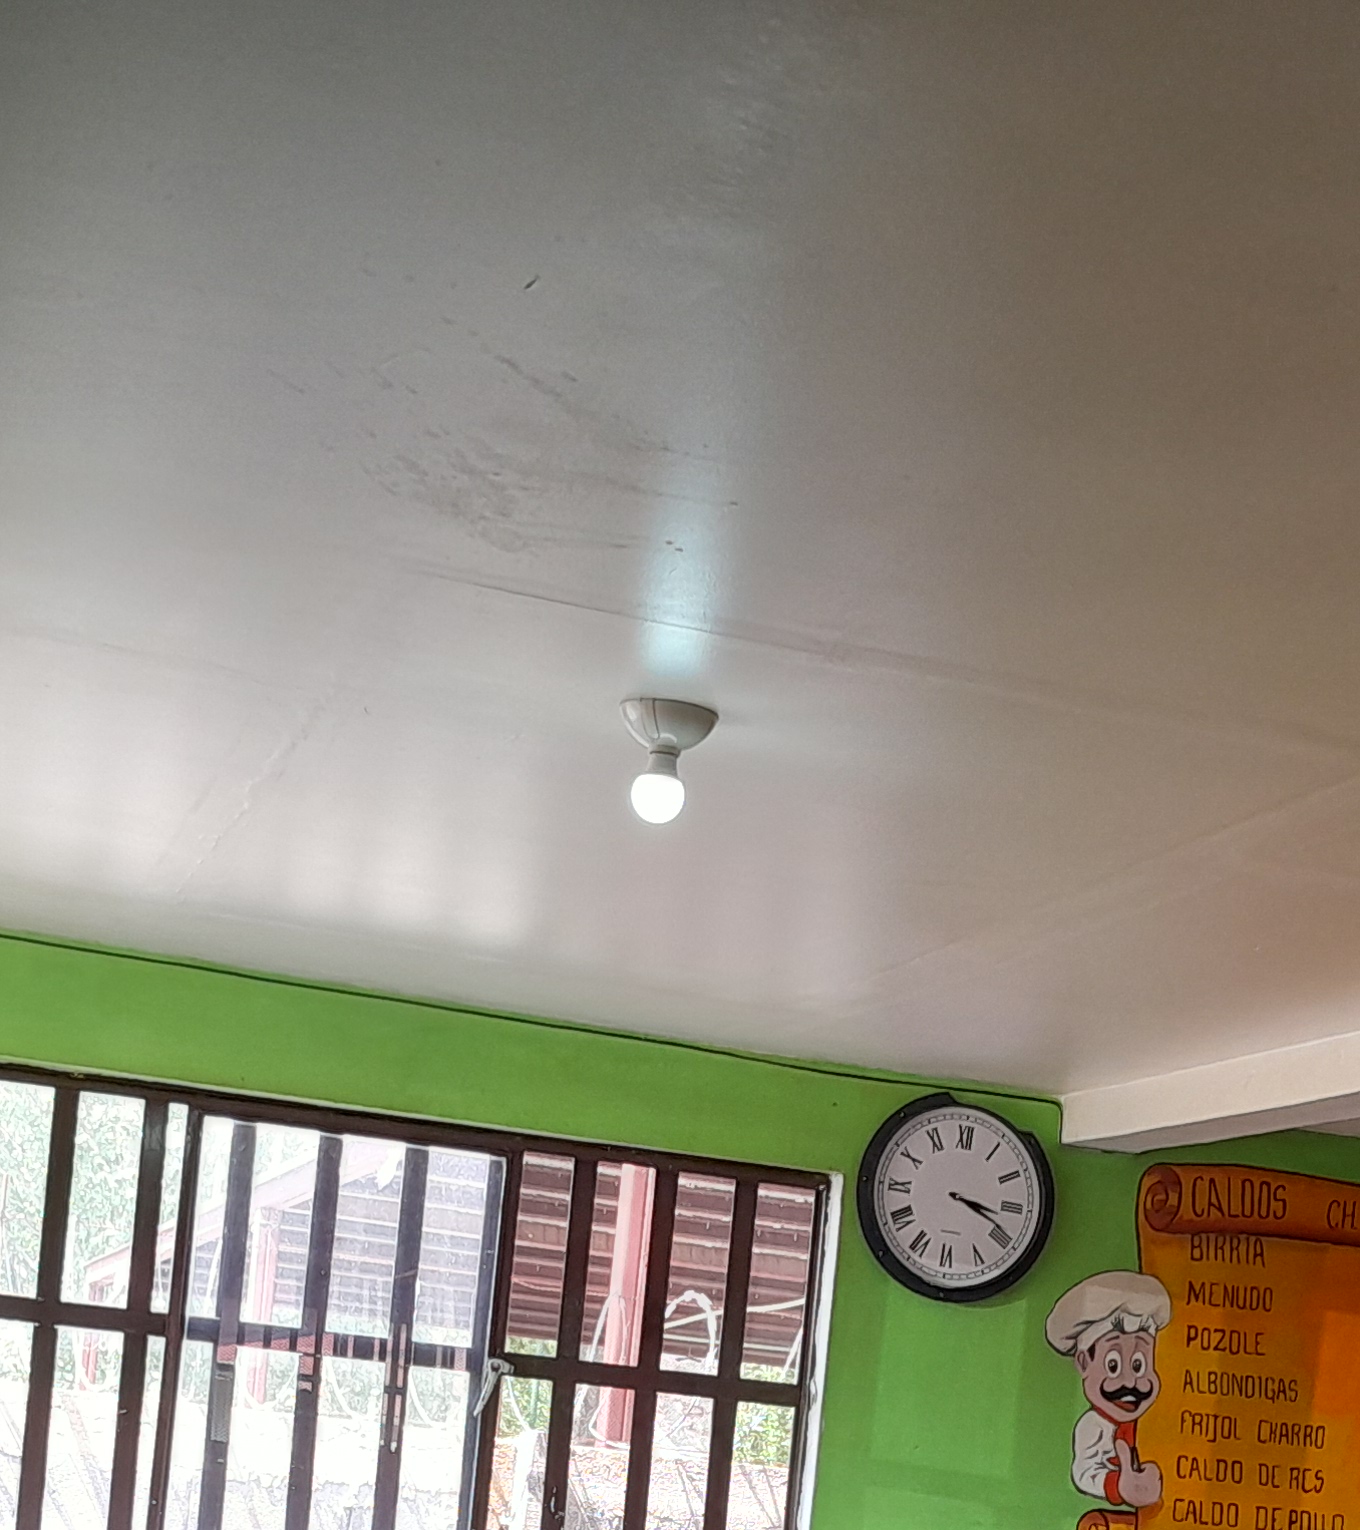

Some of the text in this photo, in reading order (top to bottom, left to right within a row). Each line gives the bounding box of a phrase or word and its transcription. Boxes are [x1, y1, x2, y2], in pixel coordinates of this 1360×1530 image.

[1191, 1176, 1287, 1220] CALDOS
[1190, 1234, 1266, 1268] BIRRIA
[1186, 1280, 1274, 1313] MENUDO
[1186, 1324, 1266, 1356] POZOLE
[1183, 1369, 1299, 1404] ALBONDIGAS
[1180, 1409, 1326, 1449] FRIJOL CHARRO
[1176, 1455, 1325, 1494] CALDO DE RES
[1172, 1498, 1239, 1528] CALDO
